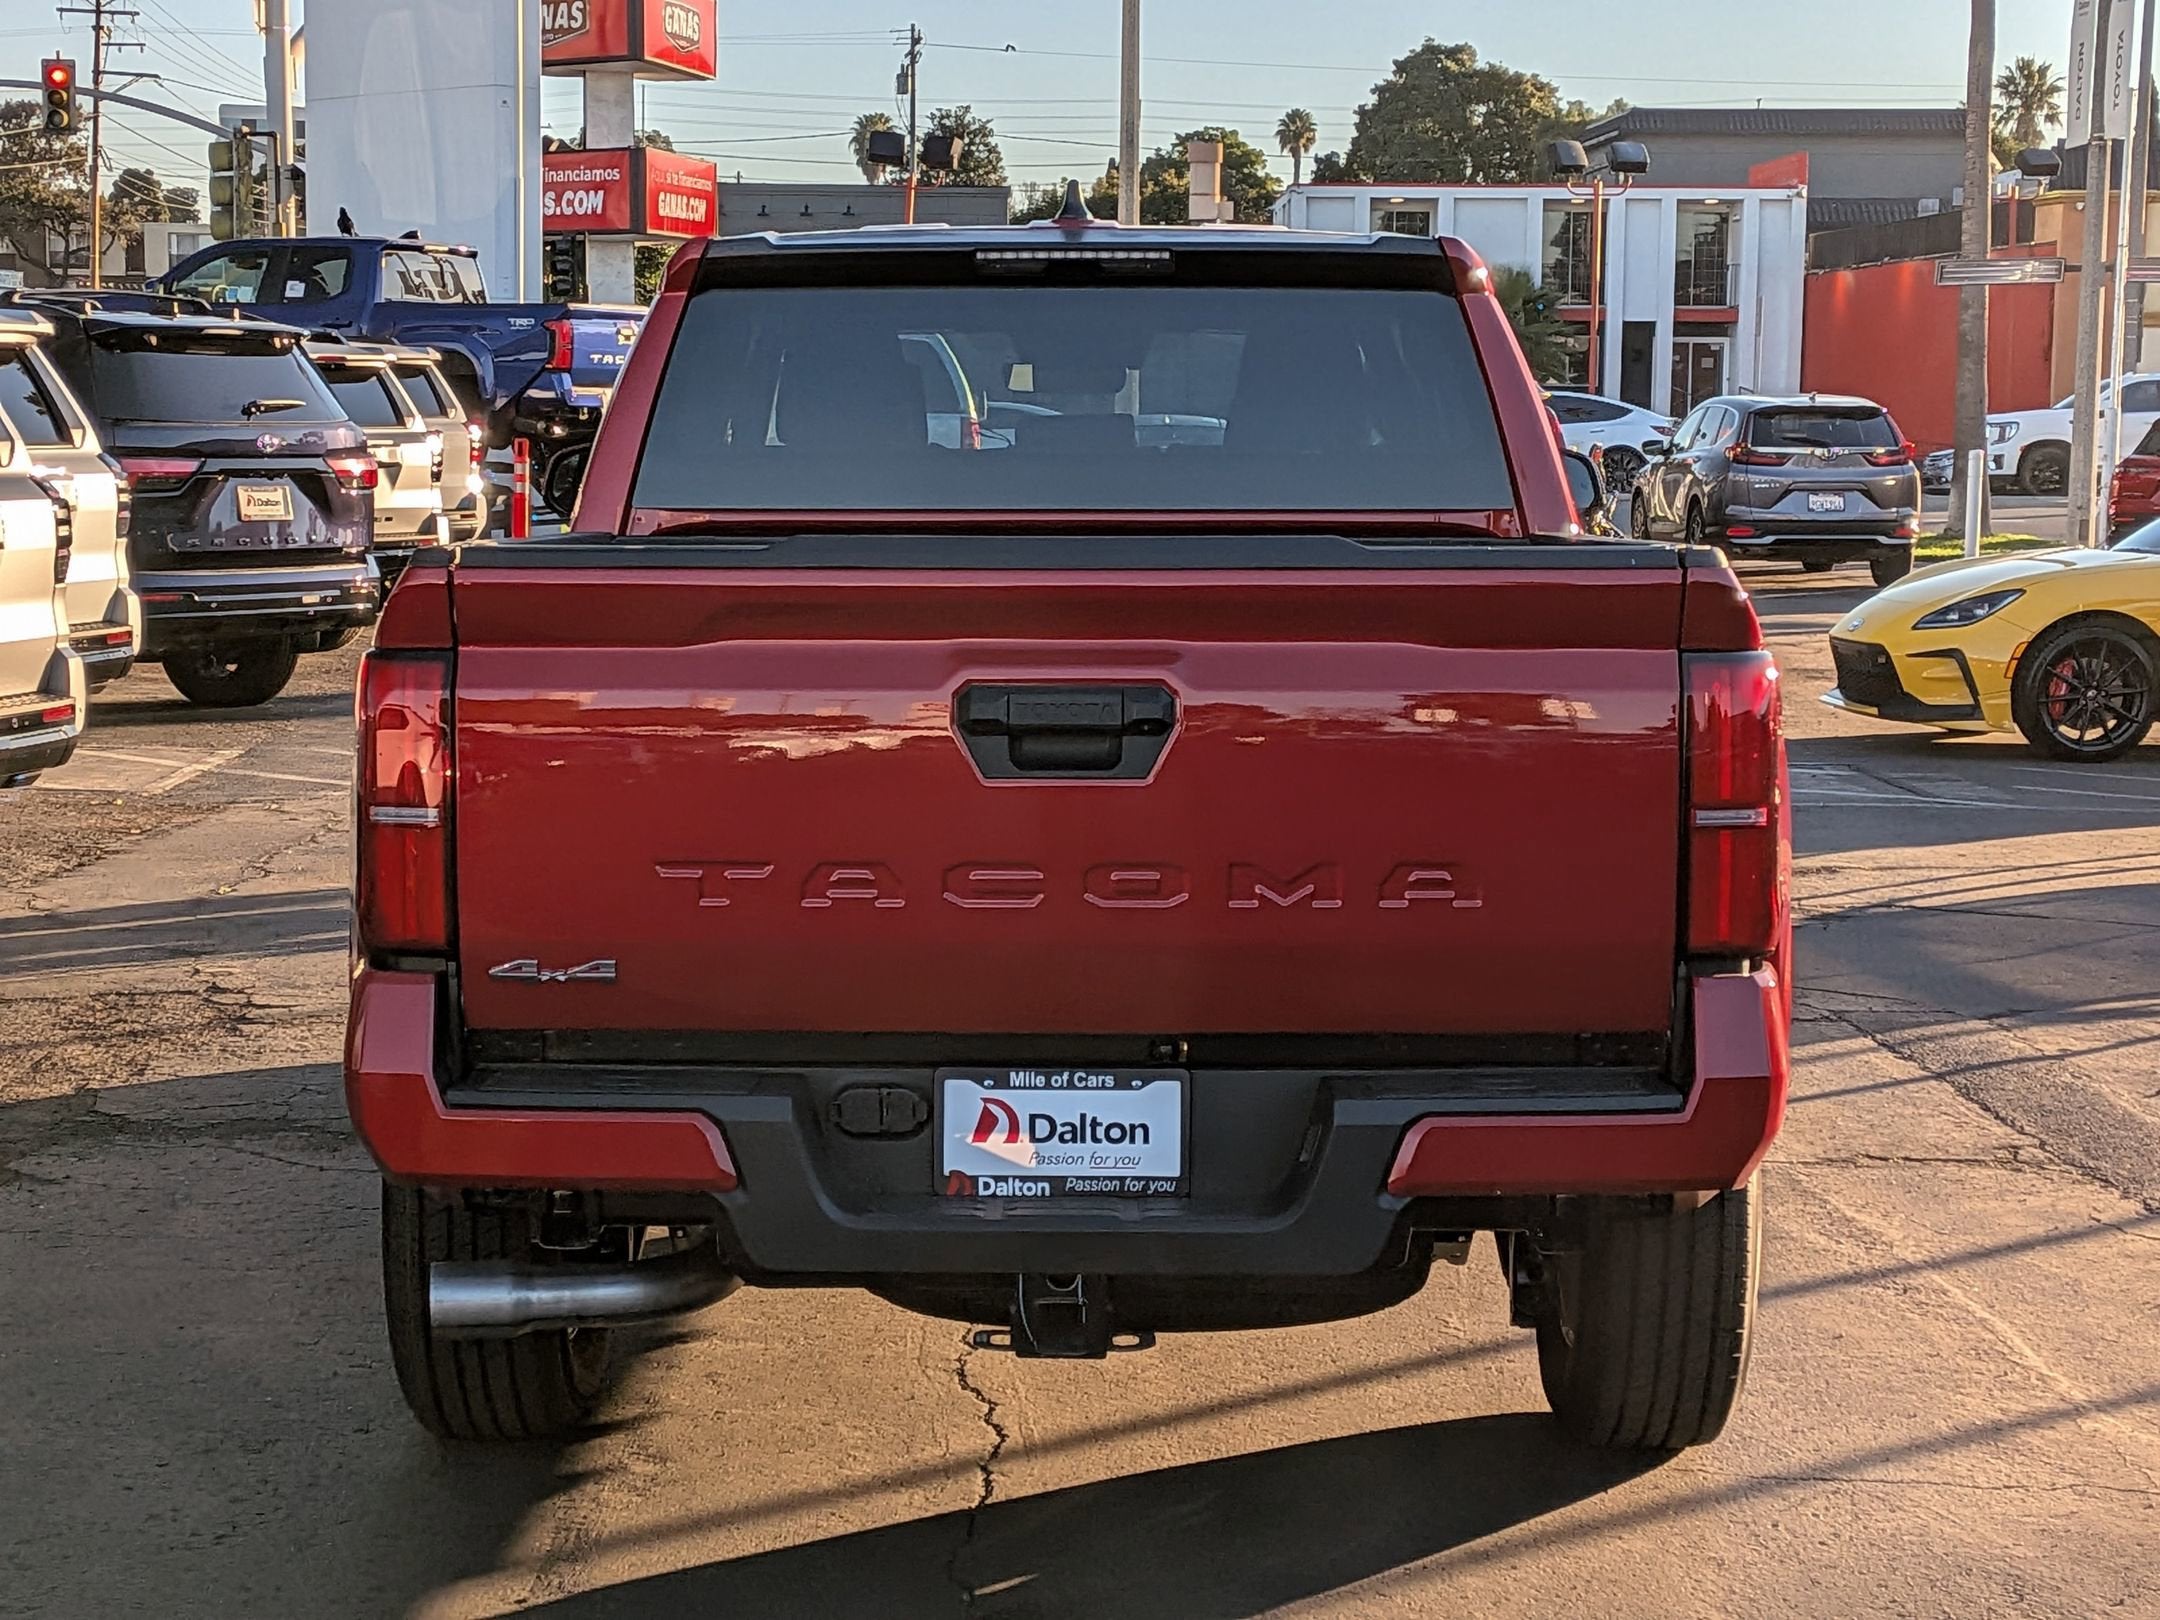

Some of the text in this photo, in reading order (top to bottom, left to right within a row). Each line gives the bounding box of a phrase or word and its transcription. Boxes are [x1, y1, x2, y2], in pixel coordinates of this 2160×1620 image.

[2075, 41, 2085, 120] DALTON
[2112, 30, 2125, 111] TOYOTA
[543, 165, 621, 183] inanciamos
[658, 191, 707, 223] GANAS.COM
[654, 860, 1483, 909] TACOMA
[488, 959, 617, 982] 4x4
[1009, 1071, 1115, 1088] Mile of Cars
[1028, 1112, 1151, 1145] Dalton
[1028, 1151, 1142, 1168] Passion for you
[977, 1176, 1177, 1197] Dalton Passion for you
